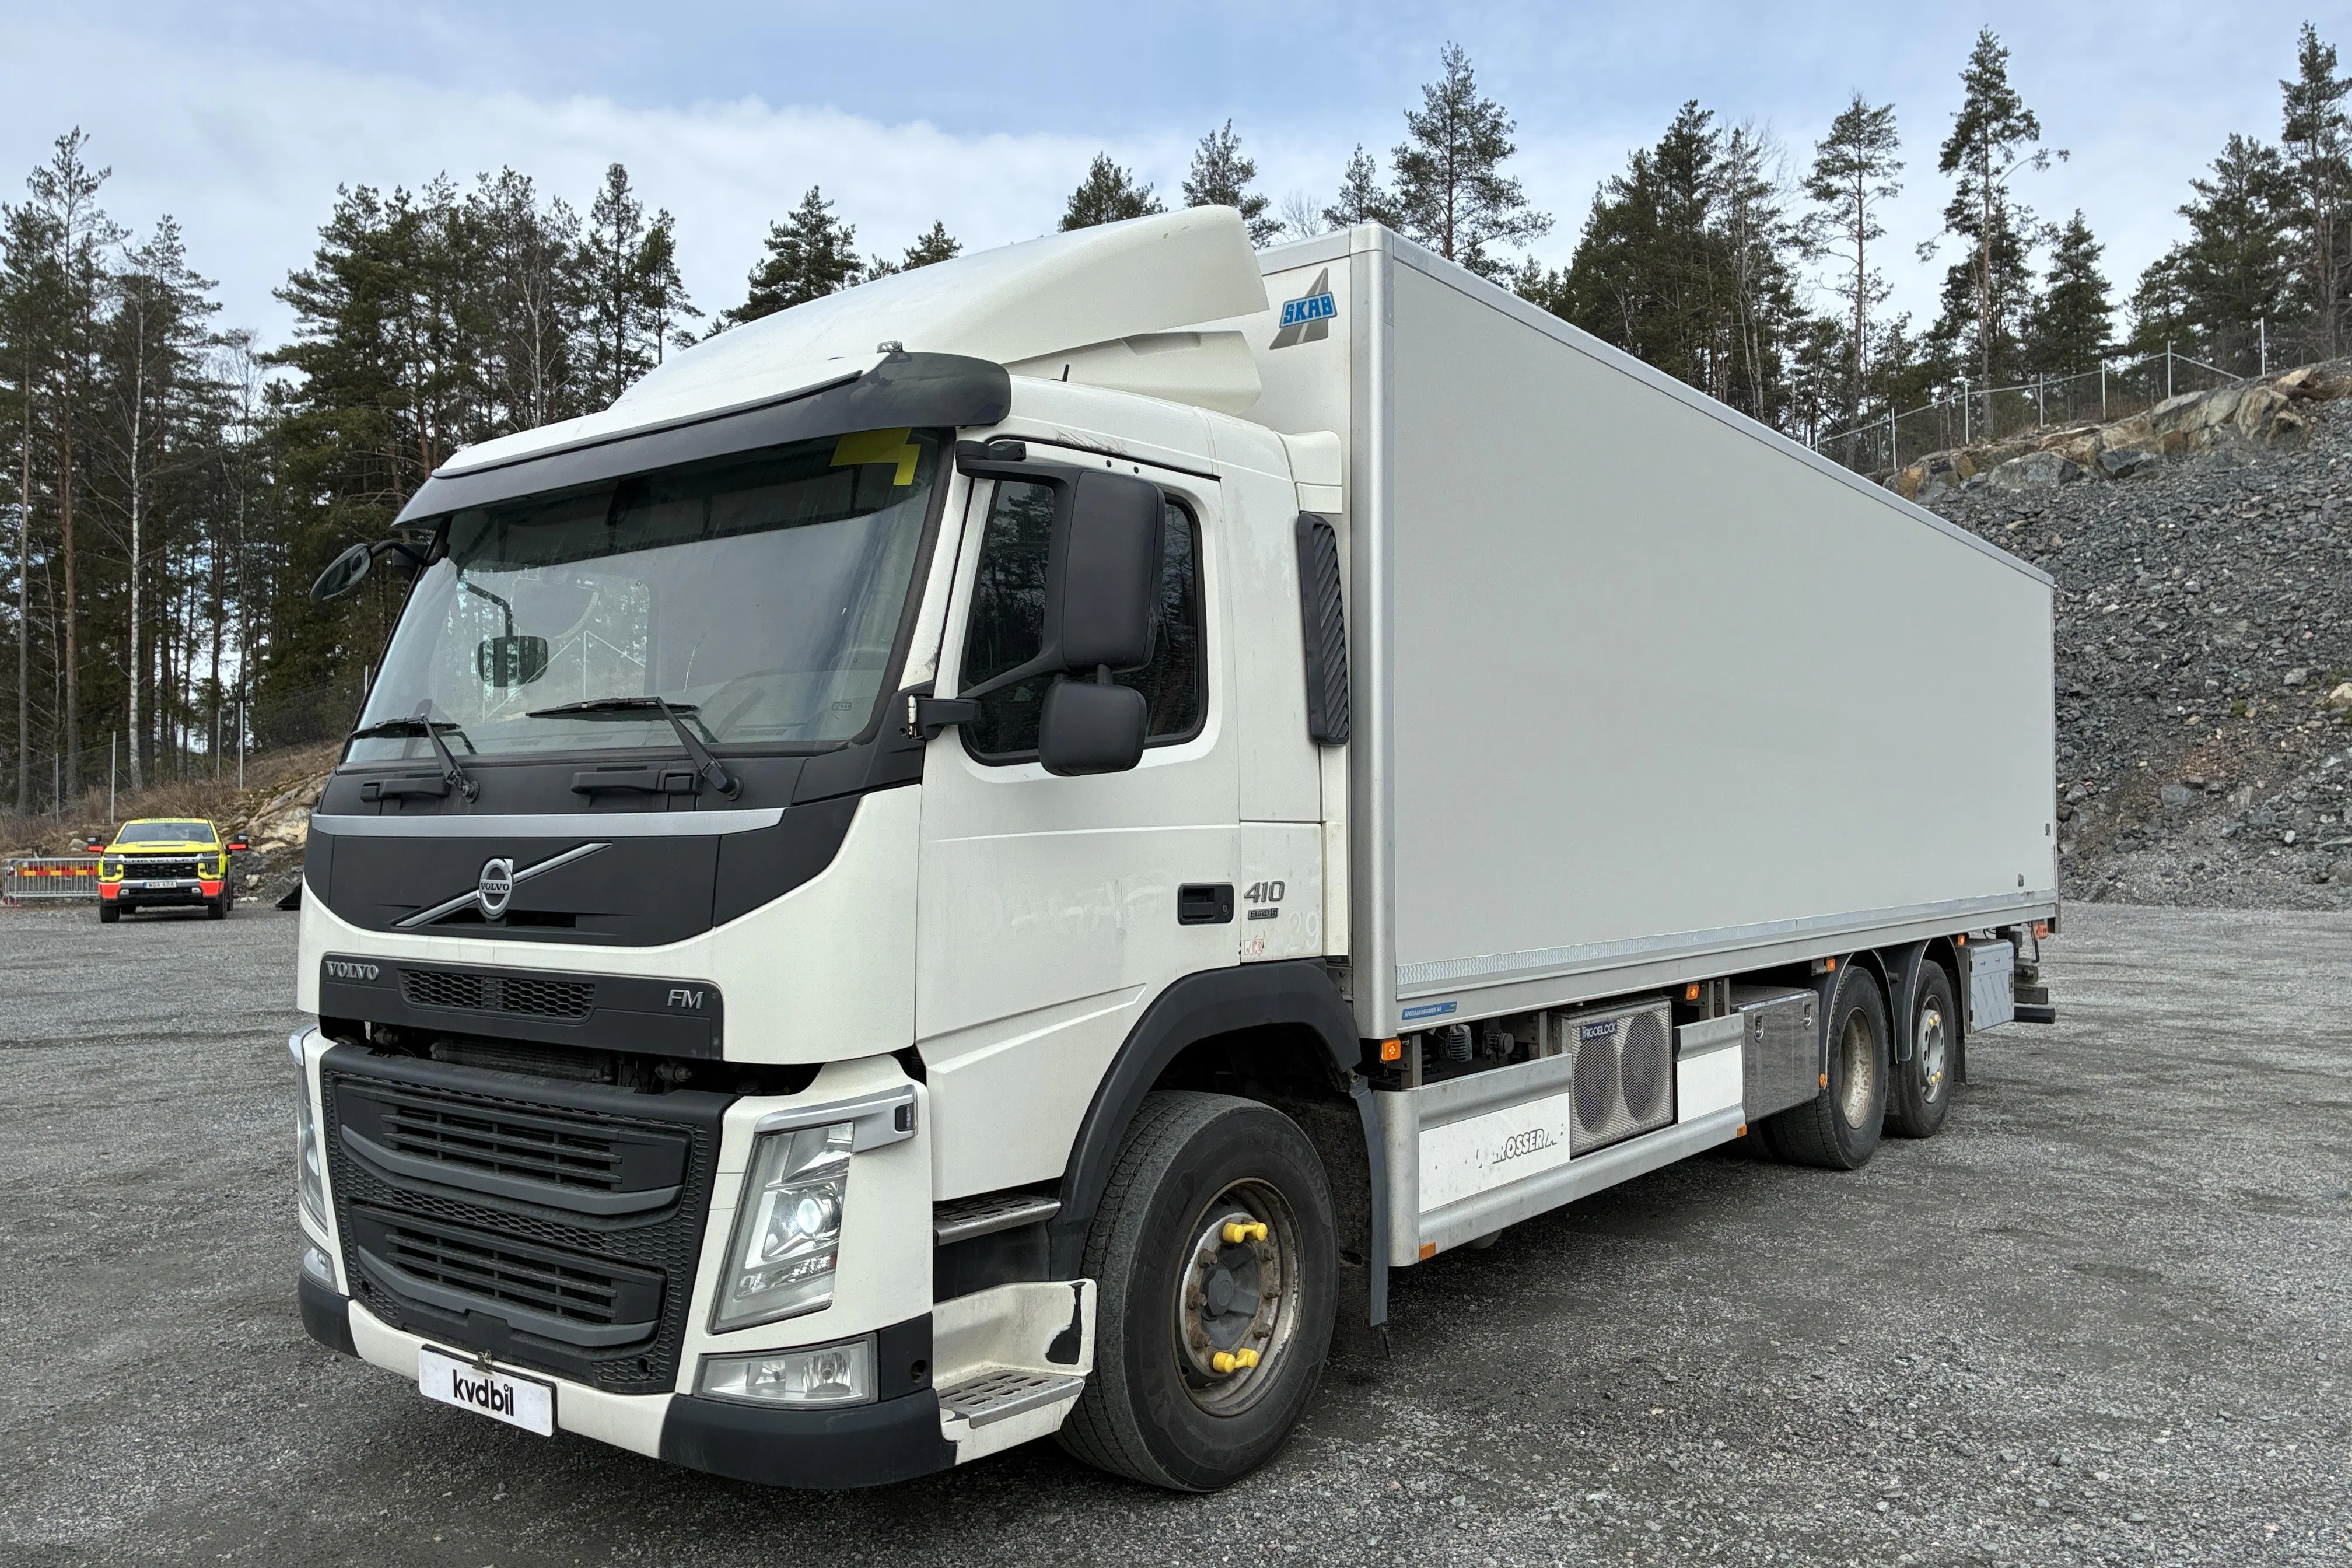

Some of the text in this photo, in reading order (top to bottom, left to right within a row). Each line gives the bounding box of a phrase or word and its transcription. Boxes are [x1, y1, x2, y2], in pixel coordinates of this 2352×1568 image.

[1283, 295, 1334, 324] SKAB
[481, 882, 510, 891] VOLVO
[1244, 881, 1285, 904] 410
[1250, 908, 1278, 918] EURO 6
[326, 961, 379, 981] VOLVO
[667, 989, 705, 1010] FM
[453, 1368, 514, 1417] kvdbil
